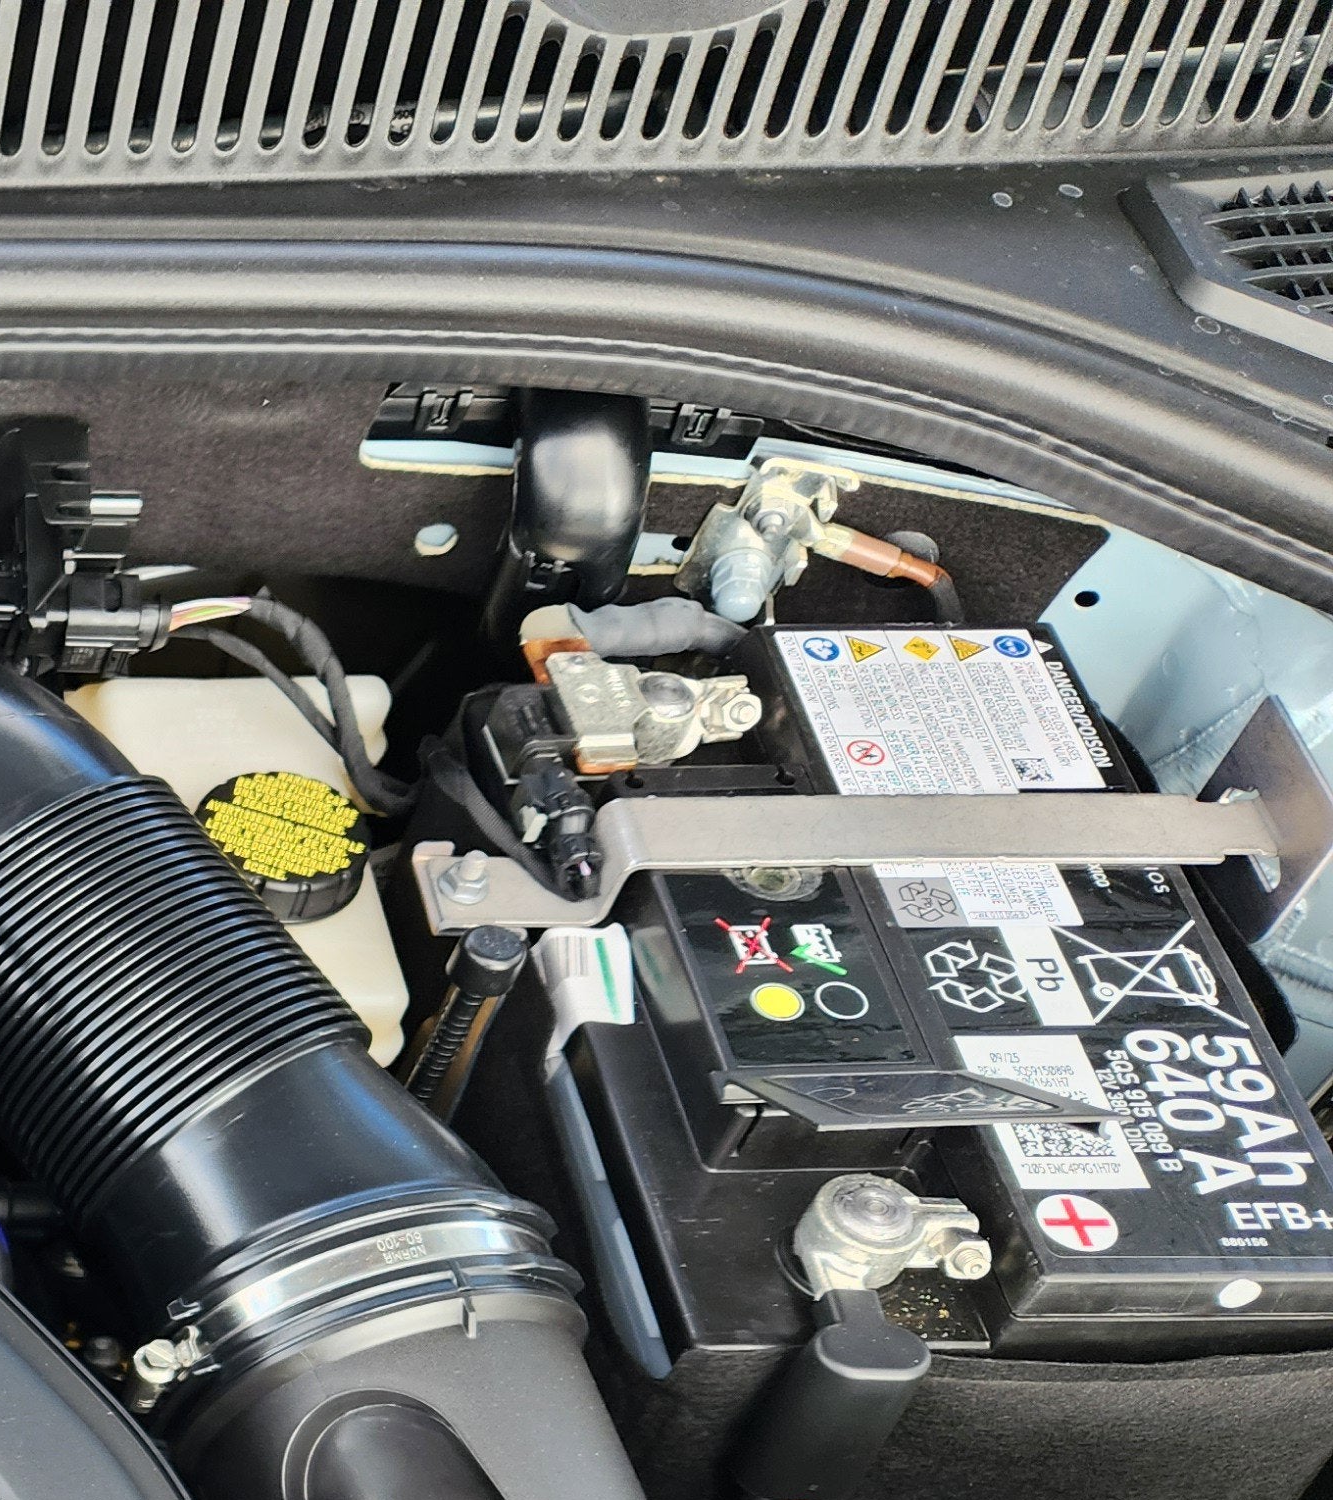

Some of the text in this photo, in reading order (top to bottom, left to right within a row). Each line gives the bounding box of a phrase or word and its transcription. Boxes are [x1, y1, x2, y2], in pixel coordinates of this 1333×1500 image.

[1041, 661, 1117, 767] DANGER/POISON
[1024, 958, 1070, 992] Pb
[1096, 1067, 1151, 1154] 12V DIN
[1104, 1049, 1183, 1173] 5QS 915 089 B
[1123, 1029, 1256, 1195] 640 A
[1190, 1034, 1314, 1187] 59Ah
[382, 1243, 427, 1265] NORMA
[1223, 1202, 1333, 1231] EFB+
